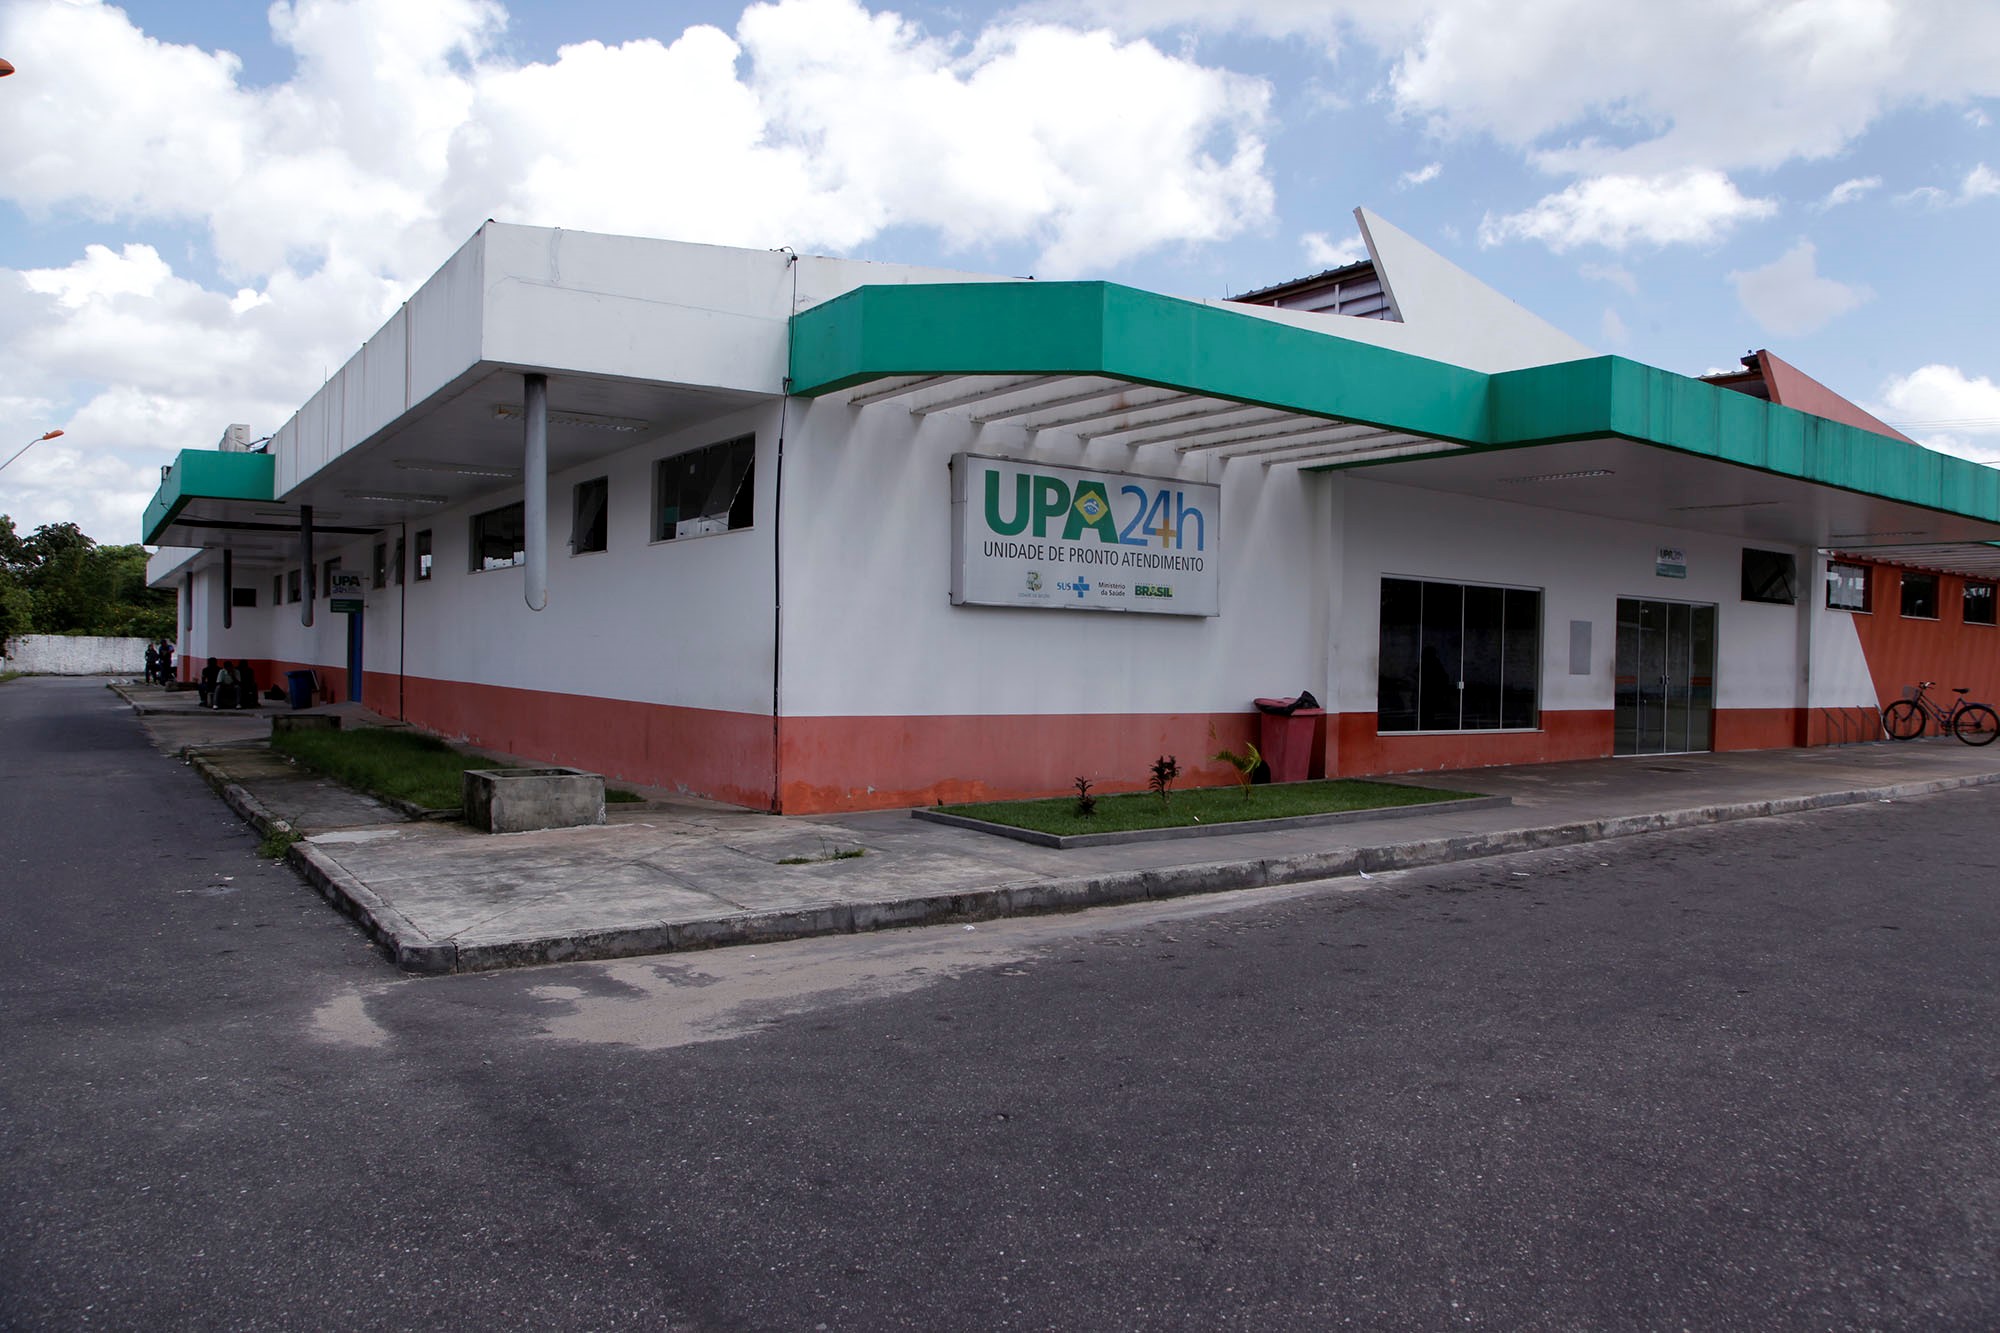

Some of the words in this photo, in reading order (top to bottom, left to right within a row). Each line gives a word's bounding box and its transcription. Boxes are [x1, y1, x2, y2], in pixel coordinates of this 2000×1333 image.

[984, 469, 1119, 544] UPA
[1119, 484, 1205, 552] 24h
[983, 541, 1044, 561] UNIDADE
[1048, 546, 1065, 562] DE
[1069, 547, 1119, 566] PRONTO
[1121, 551, 1204, 572] ATENDIMENTO
[332, 575, 361, 587] UPA
[1056, 582, 1072, 591] SUS
[1109, 589, 1126, 597] Saúde
[1135, 585, 1173, 598] BRASIL
